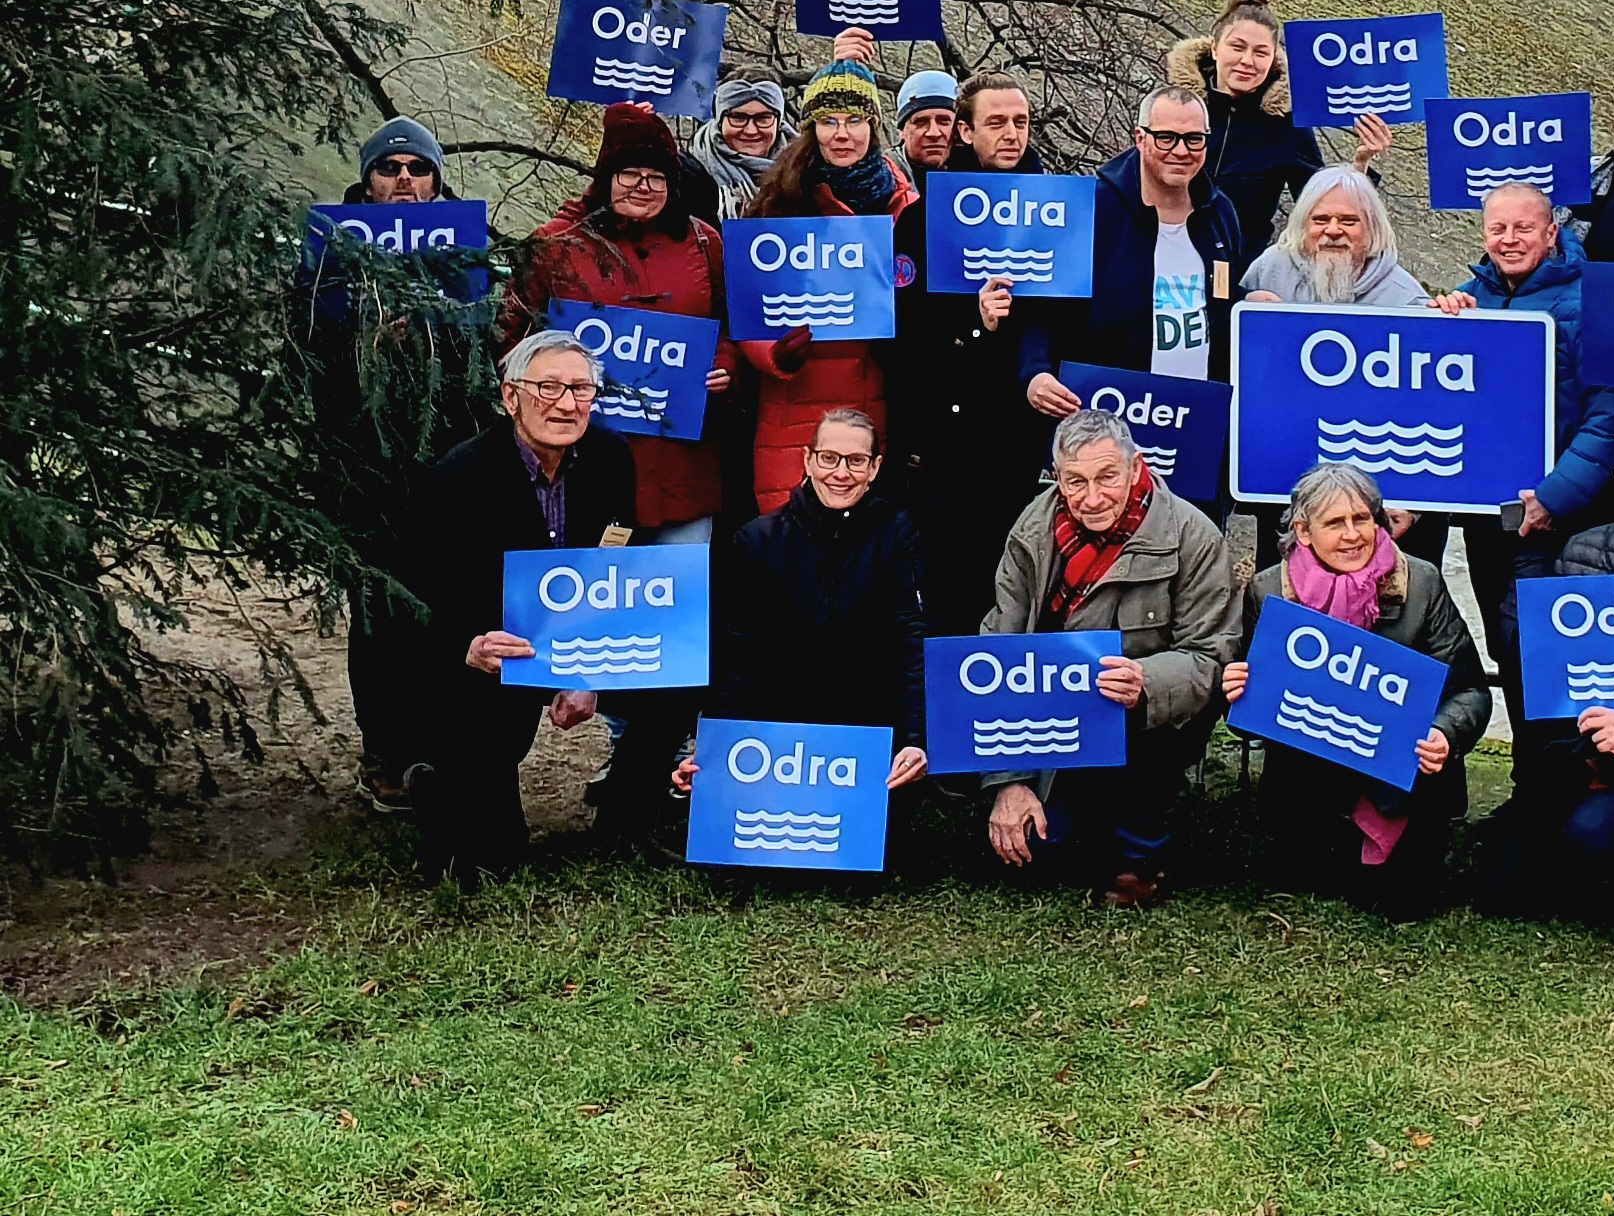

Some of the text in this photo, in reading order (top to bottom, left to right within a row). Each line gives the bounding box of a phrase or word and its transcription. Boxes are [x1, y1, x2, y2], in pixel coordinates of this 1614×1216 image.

[592, 6, 686, 49] Oder
[1312, 32, 1418, 67] Odra
[1453, 111, 1563, 147] Odra
[953, 187, 1065, 227] Odra
[750, 232, 864, 272] Odra
[573, 317, 687, 368] Odra
[1300, 329, 1475, 392] Odra
[1090, 386, 1190, 429] Oder
[538, 565, 674, 612] Odra
[959, 652, 1091, 695] Odra
[1285, 626, 1409, 707] Odra
[727, 738, 857, 787] Odra
